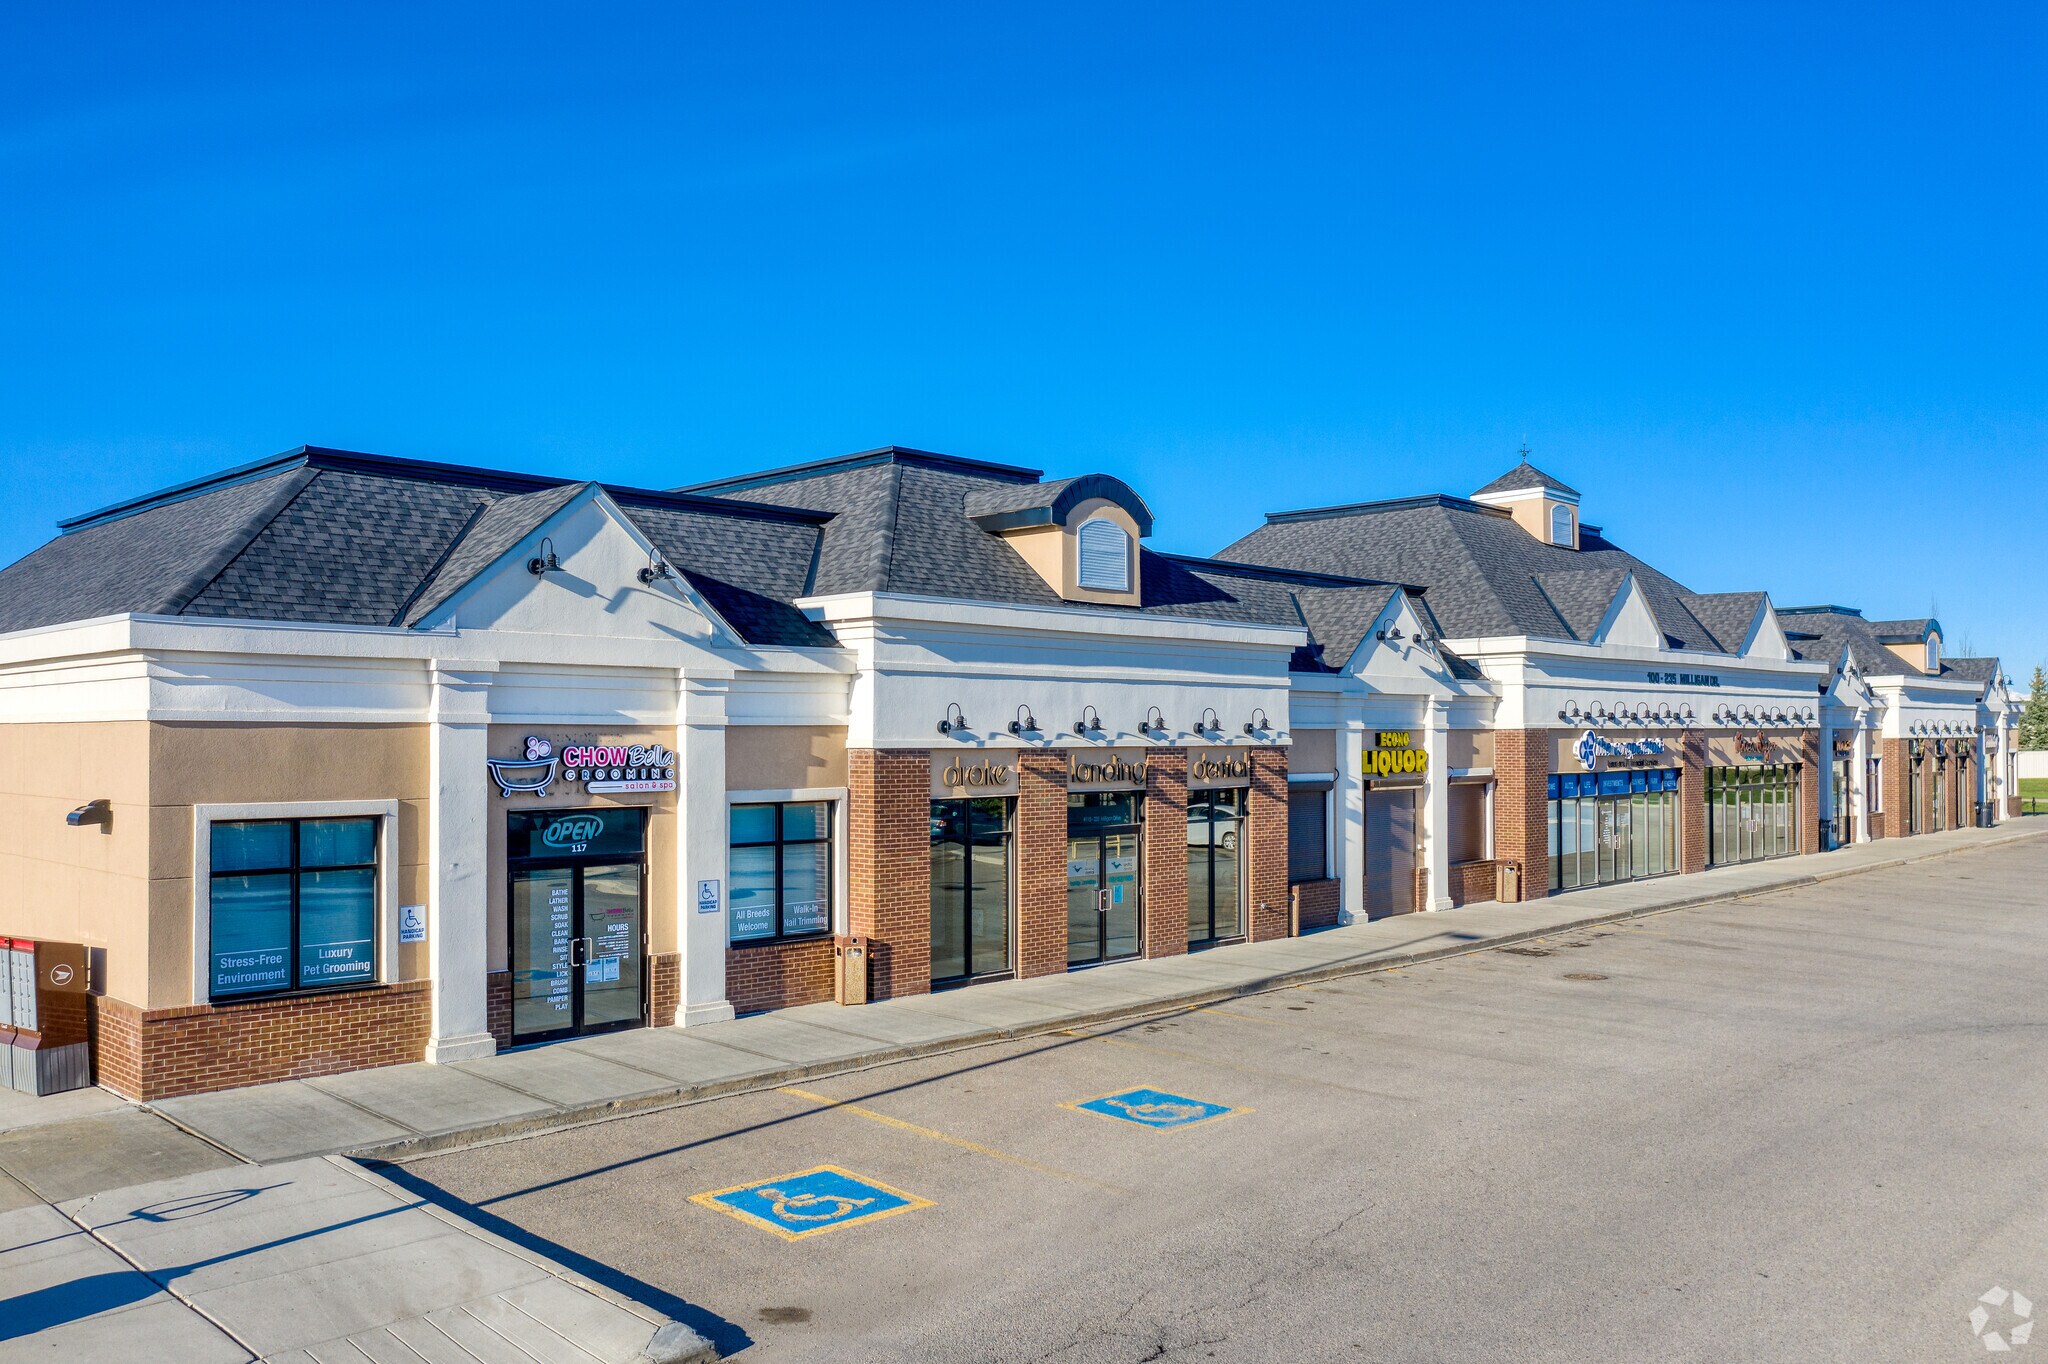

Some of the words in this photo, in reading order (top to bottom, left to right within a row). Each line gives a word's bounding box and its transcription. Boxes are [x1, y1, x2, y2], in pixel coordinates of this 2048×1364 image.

[1647, 671, 1660, 684] 100
[1680, 673, 1709, 687] MILLIGAN
[1380, 732, 1410, 747] ECONO
[563, 746, 628, 767] CHOW
[628, 744, 675, 767] Bella
[1362, 749, 1428, 777] LIQUOR
[565, 768, 675, 780] GROOMING
[943, 756, 1009, 787] drake
[1070, 754, 1147, 785] landing
[1193, 752, 1249, 781] dental
[651, 781, 657, 789] &
[659, 782, 673, 790] spa
[547, 821, 597, 841] OPEN
[571, 843, 587, 852] 117
[736, 910, 746, 920] All
[746, 908, 770, 918] Breeds
[793, 904, 819, 914] Walk-In
[551, 913, 568, 921] SCRUB
[784, 918, 797, 927] Nail
[798, 915, 828, 925] Trimming
[554, 921, 568, 929] SOAK
[607, 923, 629, 932] HOURS
[737, 921, 769, 931] Welcome
[551, 929, 568, 937] CLEAN
[318, 947, 353, 959] Luxury
[220, 954, 283, 969] Stress-Free
[552, 962, 568, 970] STYLE
[303, 965, 320, 976] Pet
[323, 960, 371, 975] Grooming
[217, 968, 286, 985] Environment
[551, 979, 568, 987] BRUSH
